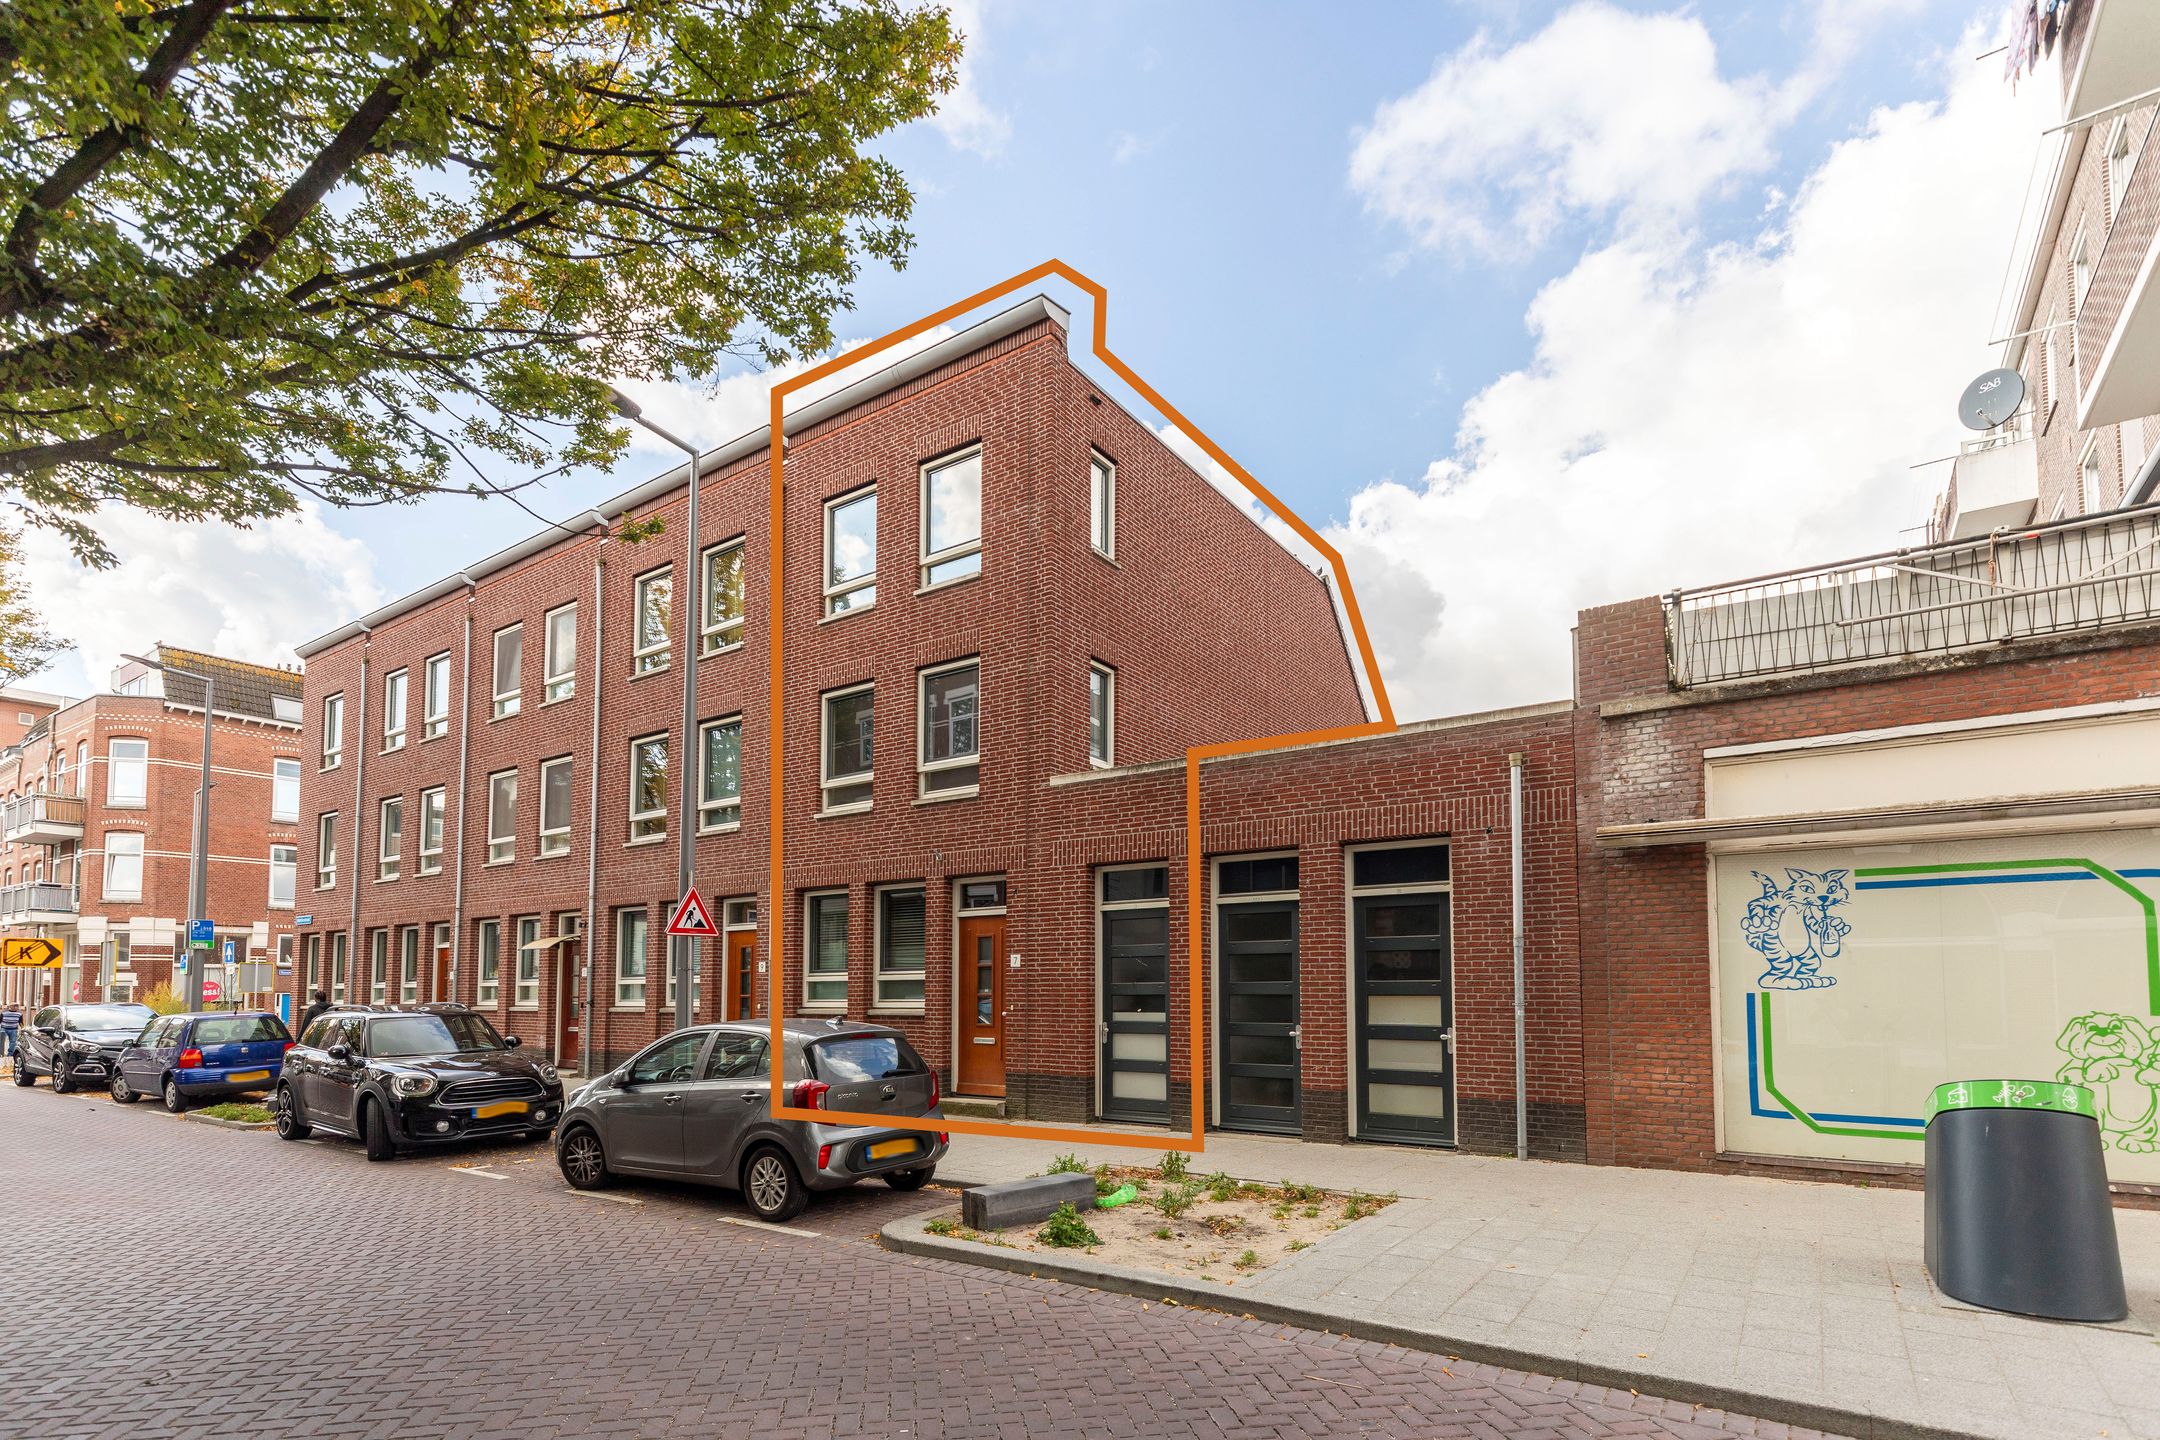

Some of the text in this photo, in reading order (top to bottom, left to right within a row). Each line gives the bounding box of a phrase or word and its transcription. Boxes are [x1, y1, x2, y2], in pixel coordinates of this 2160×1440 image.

[1979, 377, 2001, 394] SAB
[192, 921, 200, 930] P
[20, 946, 32, 960] K
